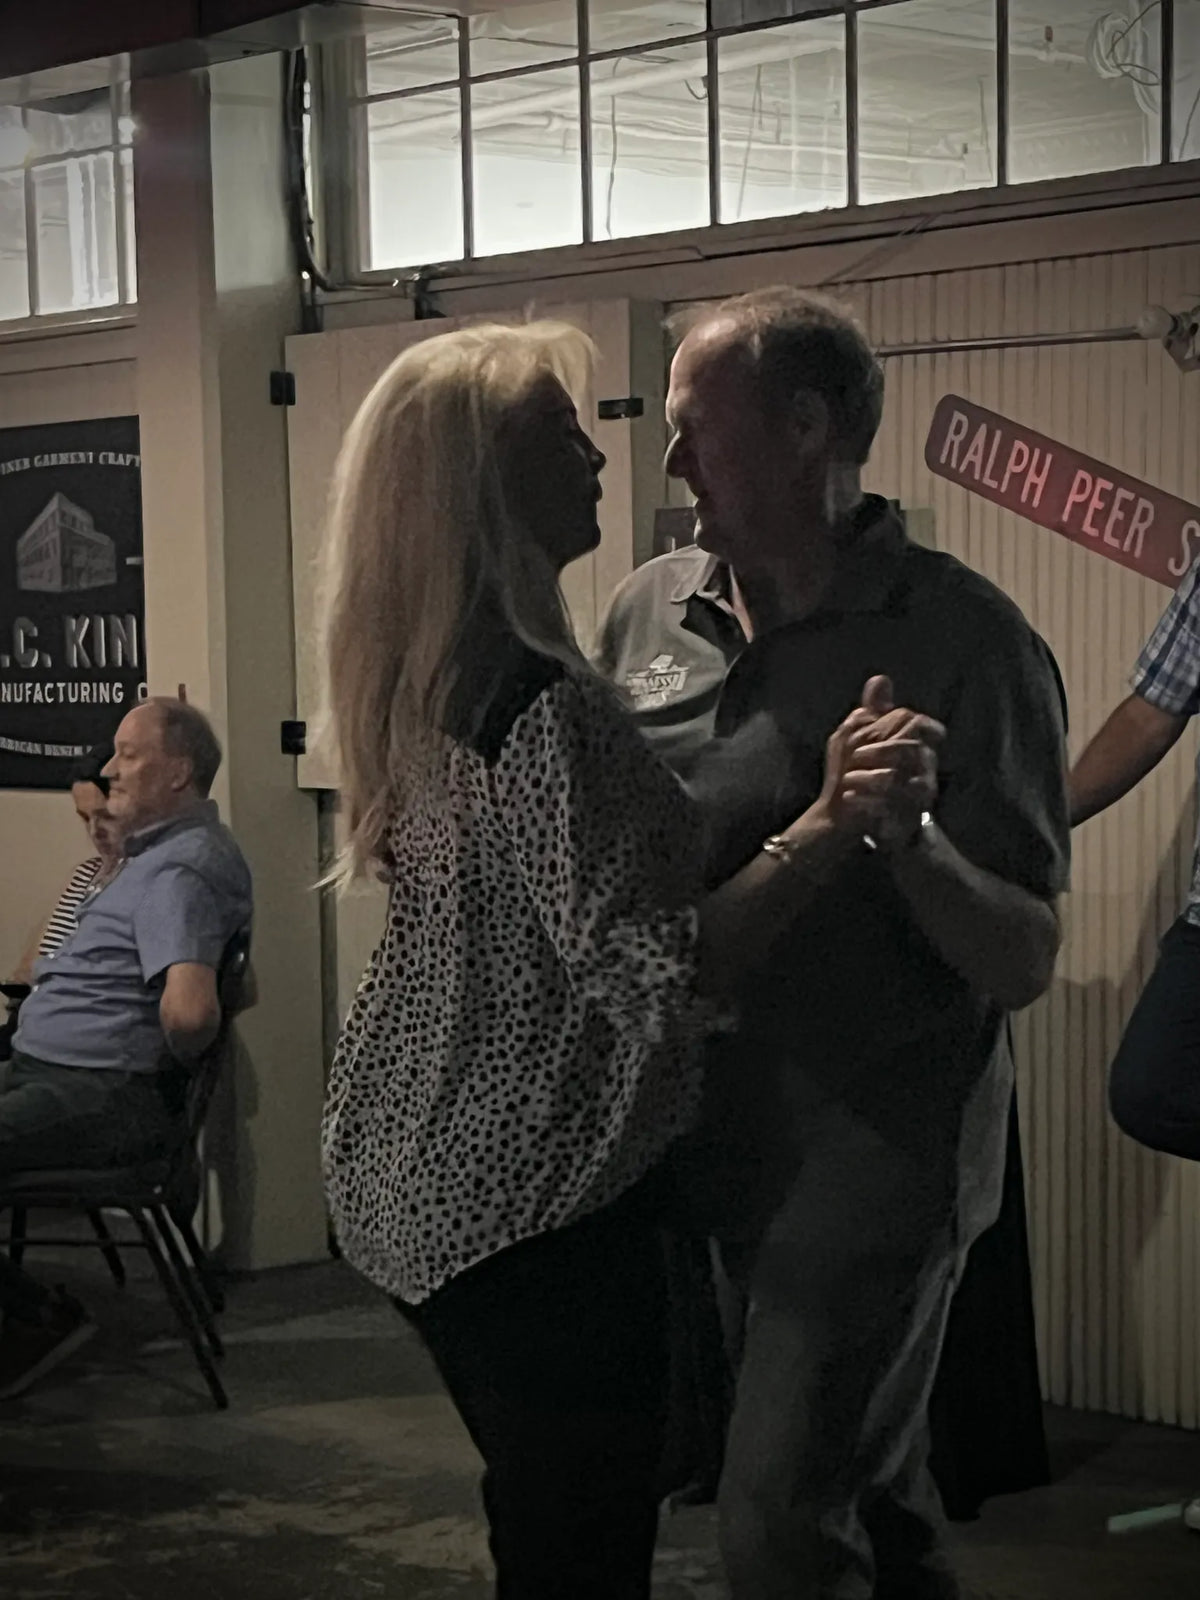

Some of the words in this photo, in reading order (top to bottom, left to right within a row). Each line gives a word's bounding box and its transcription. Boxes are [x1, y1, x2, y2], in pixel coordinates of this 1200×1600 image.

[939, 410, 1053, 509] RALPH
[1061, 469, 1155, 558] PEER
[1, 682, 124, 703] NUFACTURING
